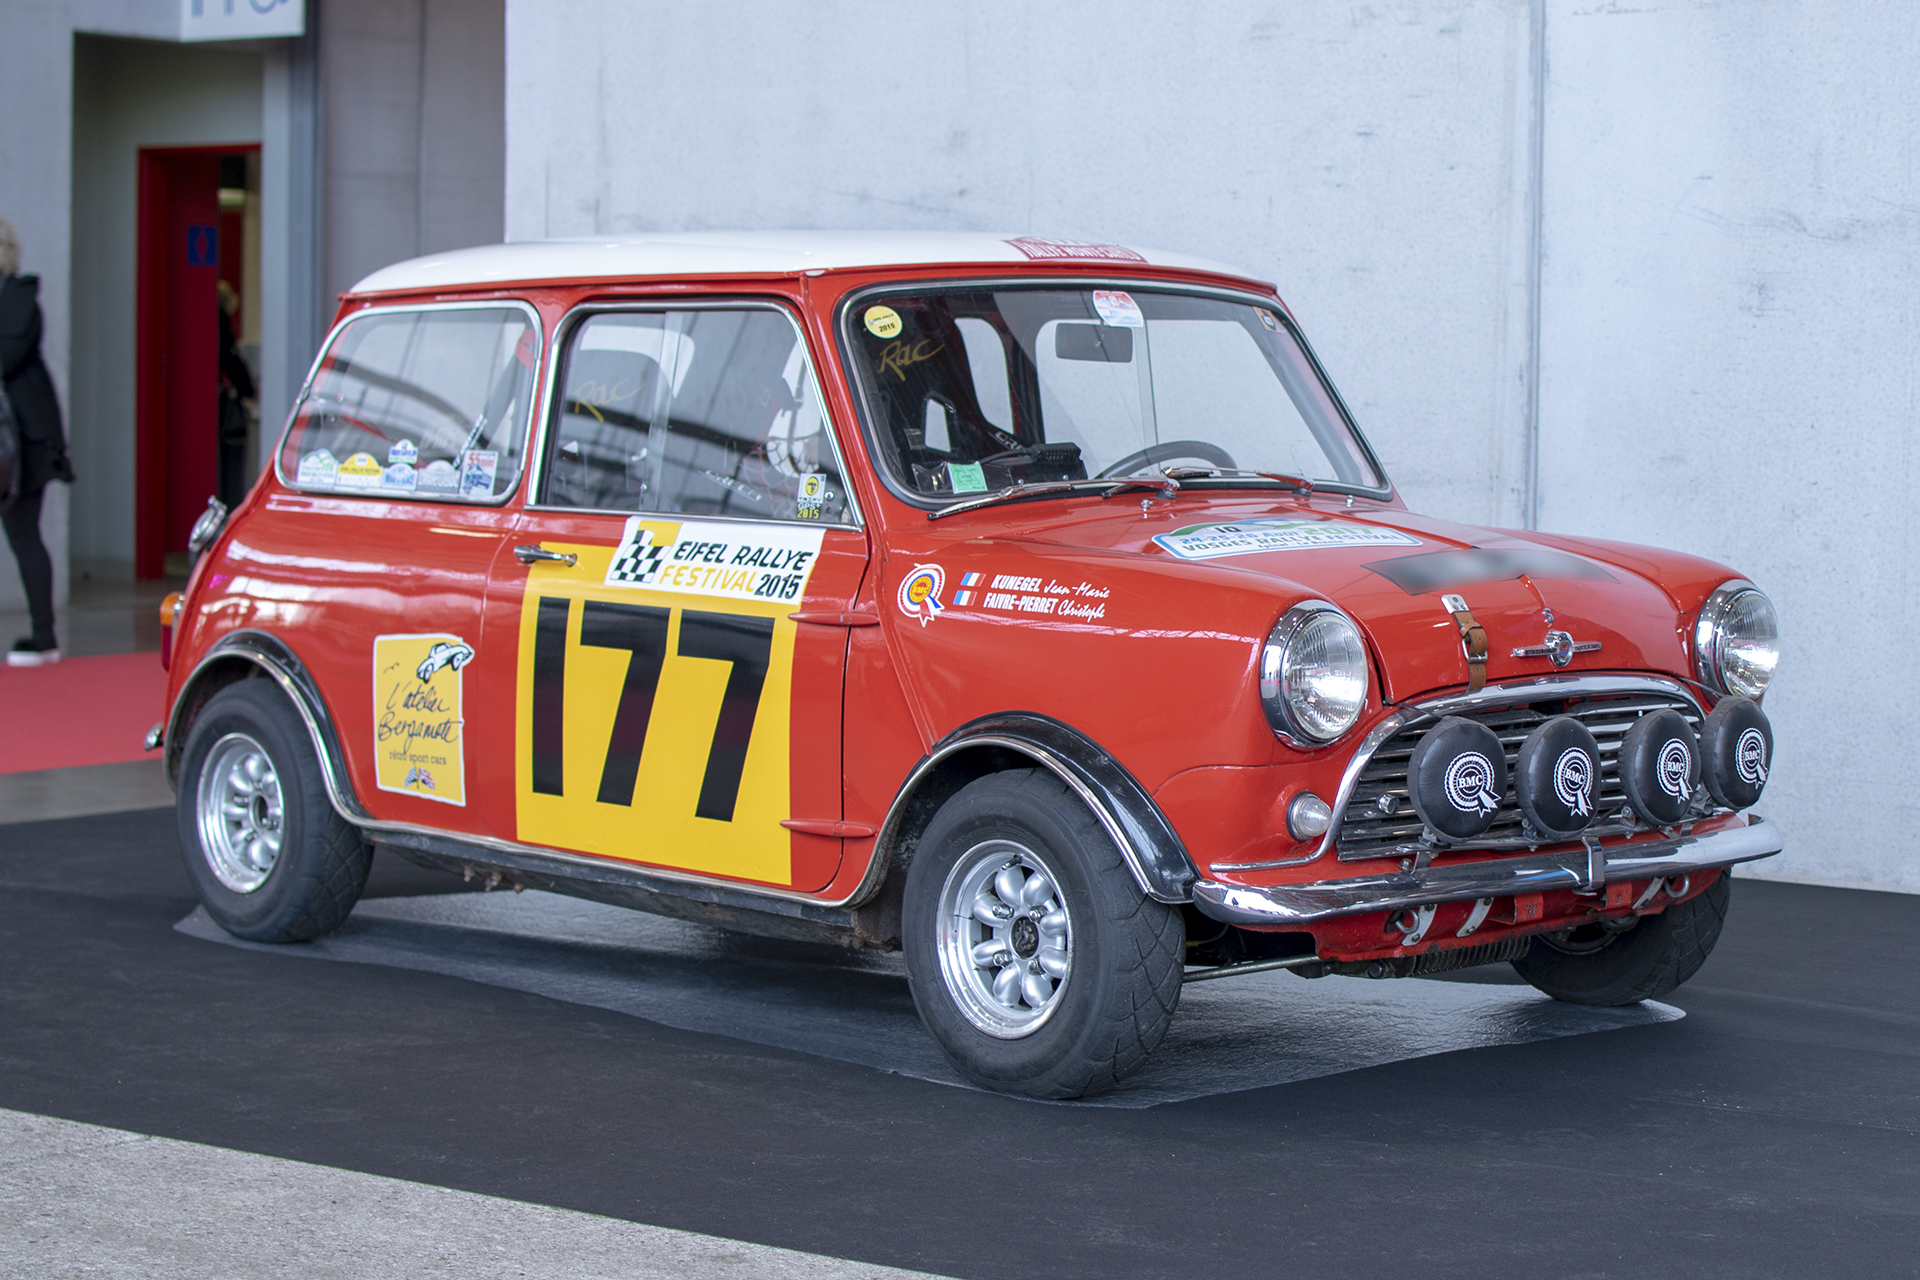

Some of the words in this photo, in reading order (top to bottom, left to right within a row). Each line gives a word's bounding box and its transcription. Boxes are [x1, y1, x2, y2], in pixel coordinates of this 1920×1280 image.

[879, 322, 896, 332] 2015
[797, 508, 820, 519] 2015
[1297, 526, 1373, 535] 2017
[1182, 540, 1253, 552] VOSGES
[1254, 536, 1323, 545] RALLYE
[673, 541, 728, 564] EIFEL
[730, 545, 814, 571] RALLYE
[659, 565, 757, 593] FESTIVAL
[753, 574, 804, 600] 2015
[991, 574, 1043, 593] KUNEGEL
[912, 586, 929, 594] BMC
[983, 592, 1059, 614] FAIVRE-PIERRET
[1057, 599, 1106, 623] Christophe
[532, 596, 776, 823] 177
[409, 753, 429, 765] sport
[430, 755, 447, 765] cars
[1744, 750, 1760, 761] BMC
[1667, 762, 1685, 773] BMC
[1458, 775, 1483, 789] BMC
[1565, 769, 1585, 785] BMC
